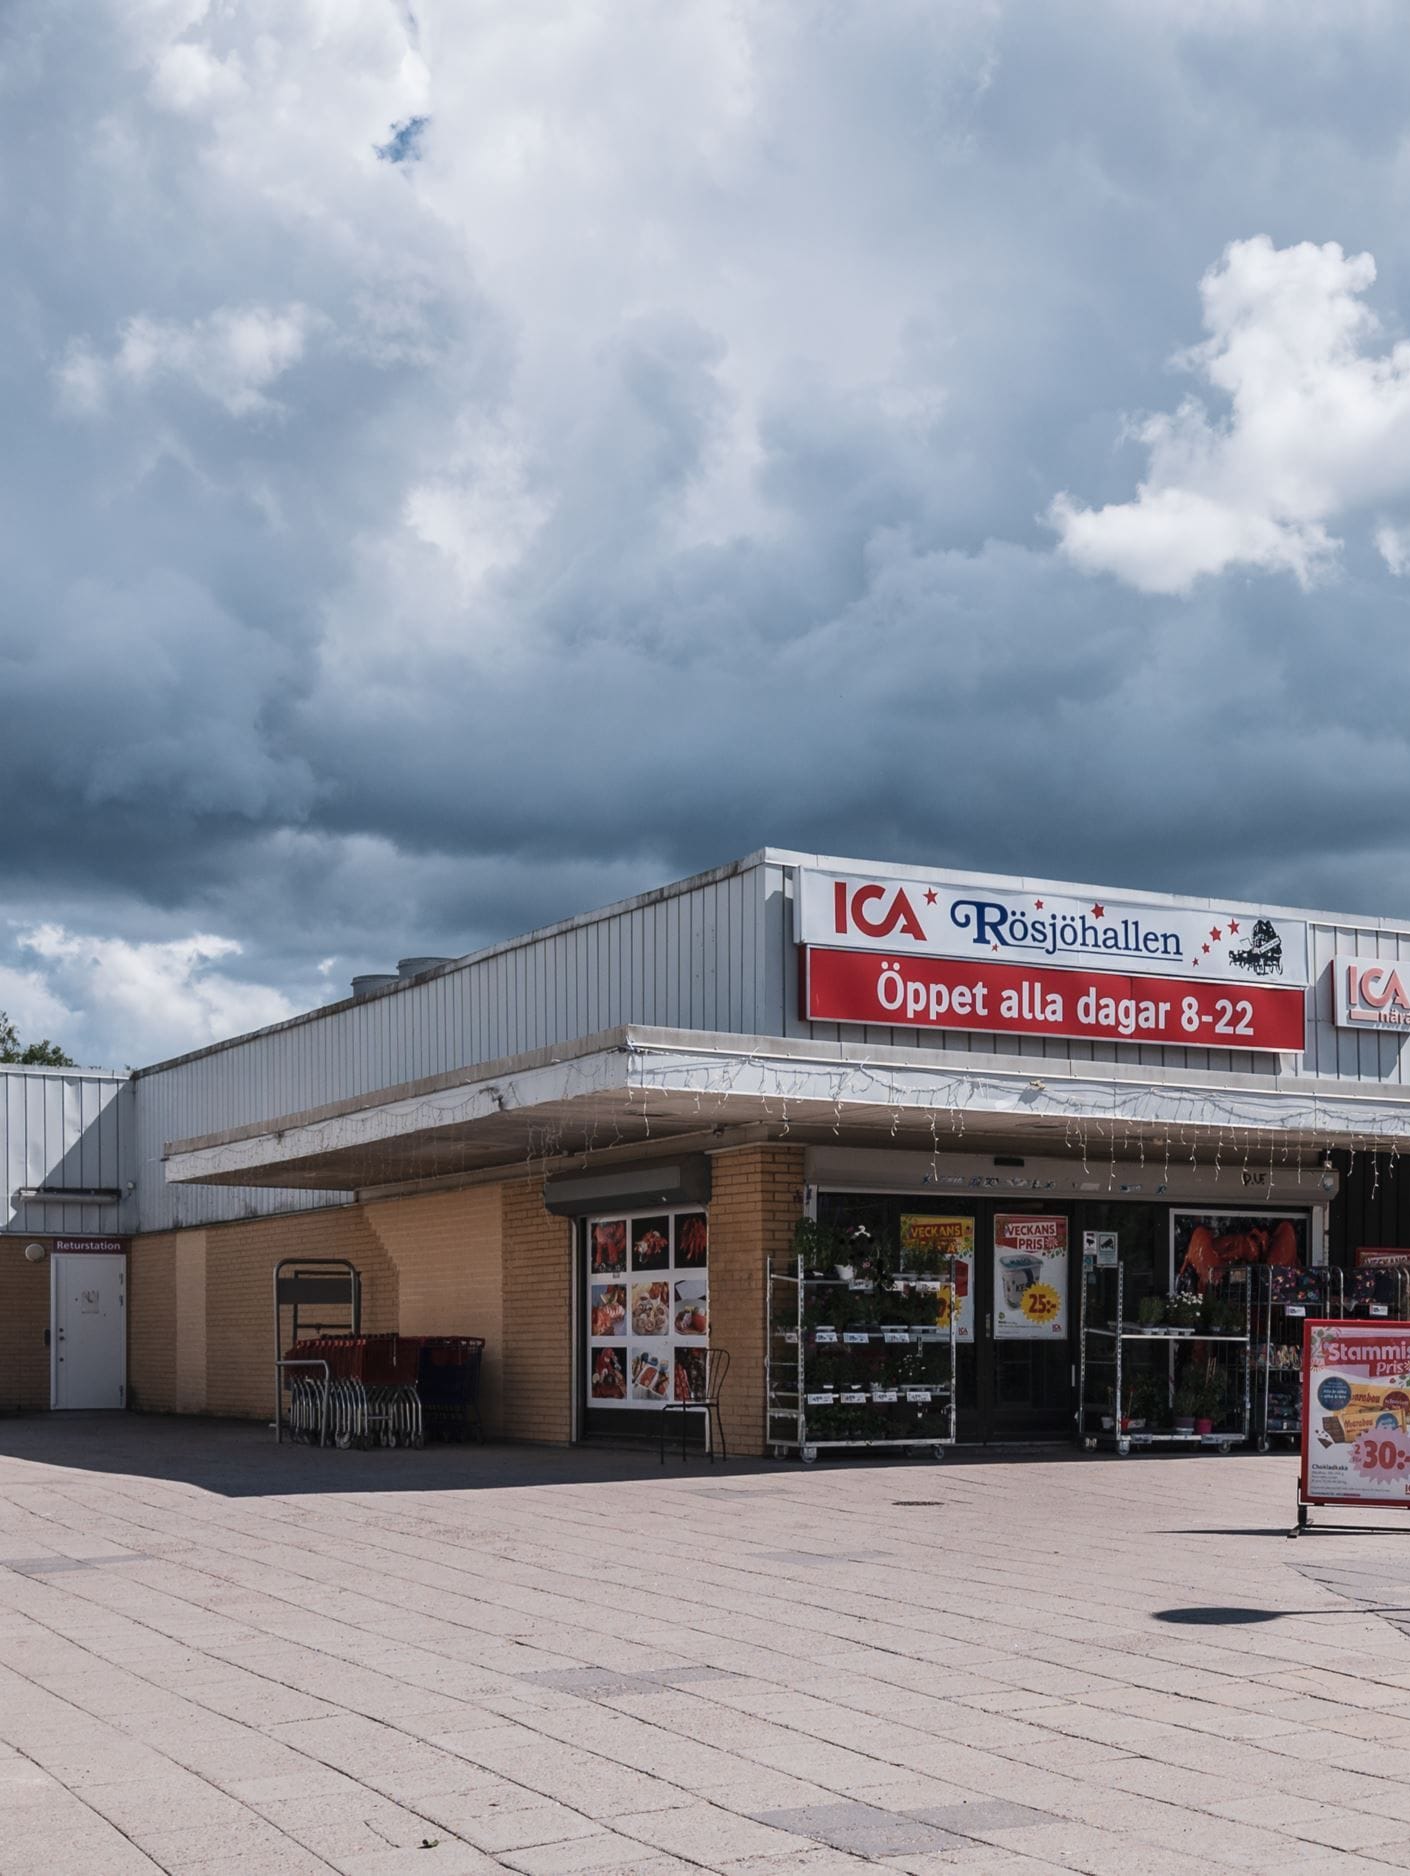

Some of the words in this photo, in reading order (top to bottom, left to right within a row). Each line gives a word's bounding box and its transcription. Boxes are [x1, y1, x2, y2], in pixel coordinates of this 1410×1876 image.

[834, 880, 928, 942] ICA
[949, 899, 1184, 957] Rösjöhallen
[876, 961, 988, 1020] Öppet
[1000, 981, 1064, 1022] alla
[1076, 987, 1171, 1035] dagar
[1180, 995, 1254, 1036] 8-22
[911, 1224, 961, 1238] VECKANS
[1006, 1224, 1056, 1237] VECKANS
[56, 1240, 121, 1250] Returstation
[1018, 1238, 1044, 1250] PRIS
[1028, 1293, 1057, 1314] 25:-
